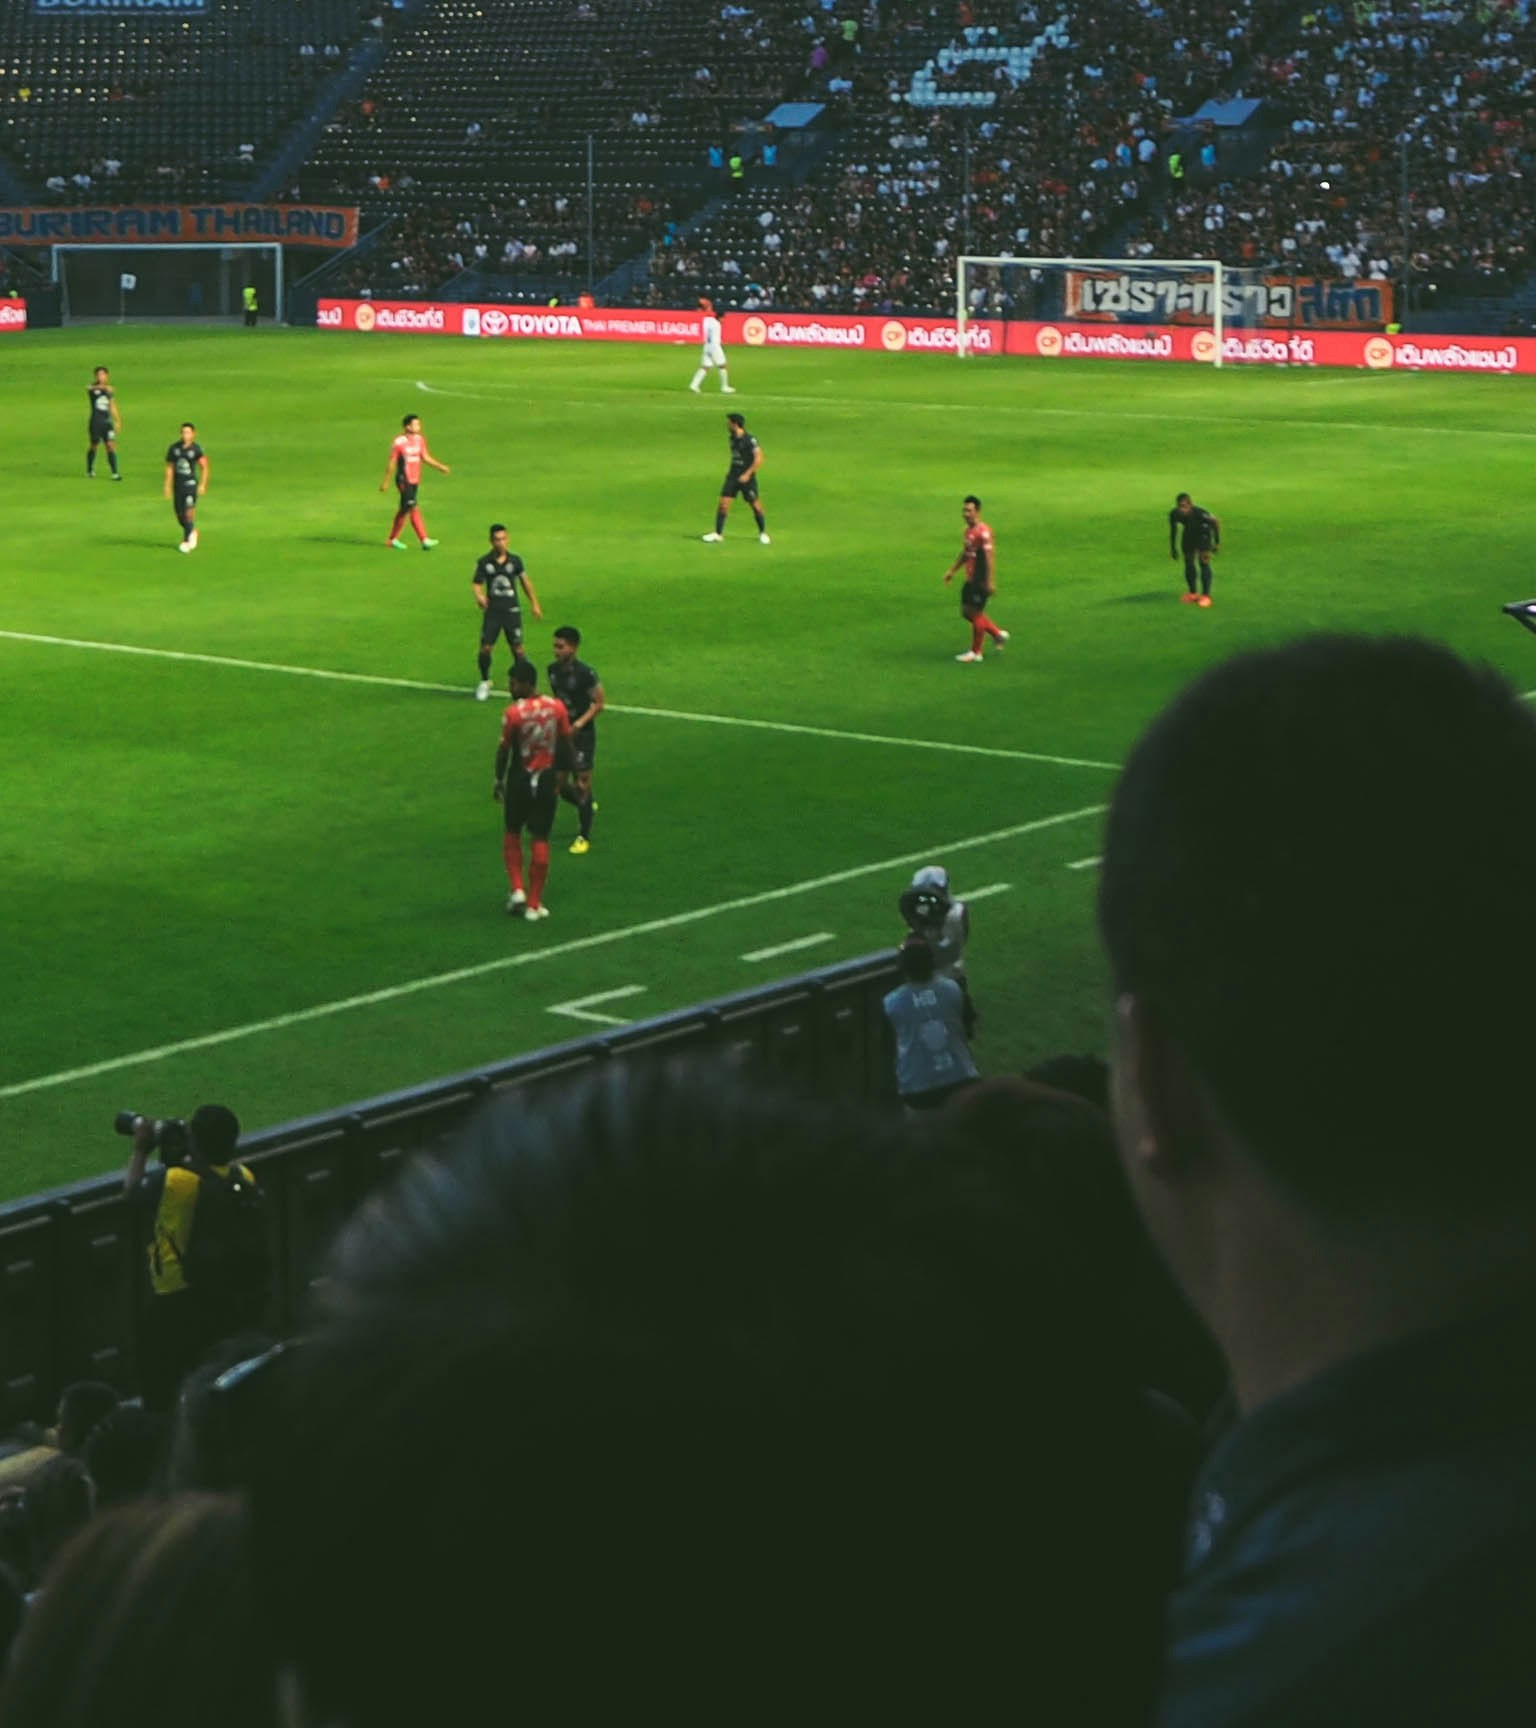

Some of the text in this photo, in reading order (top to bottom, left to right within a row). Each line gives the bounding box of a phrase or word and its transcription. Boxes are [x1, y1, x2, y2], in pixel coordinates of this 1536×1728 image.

[190, 207, 345, 240] THAILAND
[508, 313, 700, 337] TOYOTA THAI PREMIER LEAGUE
